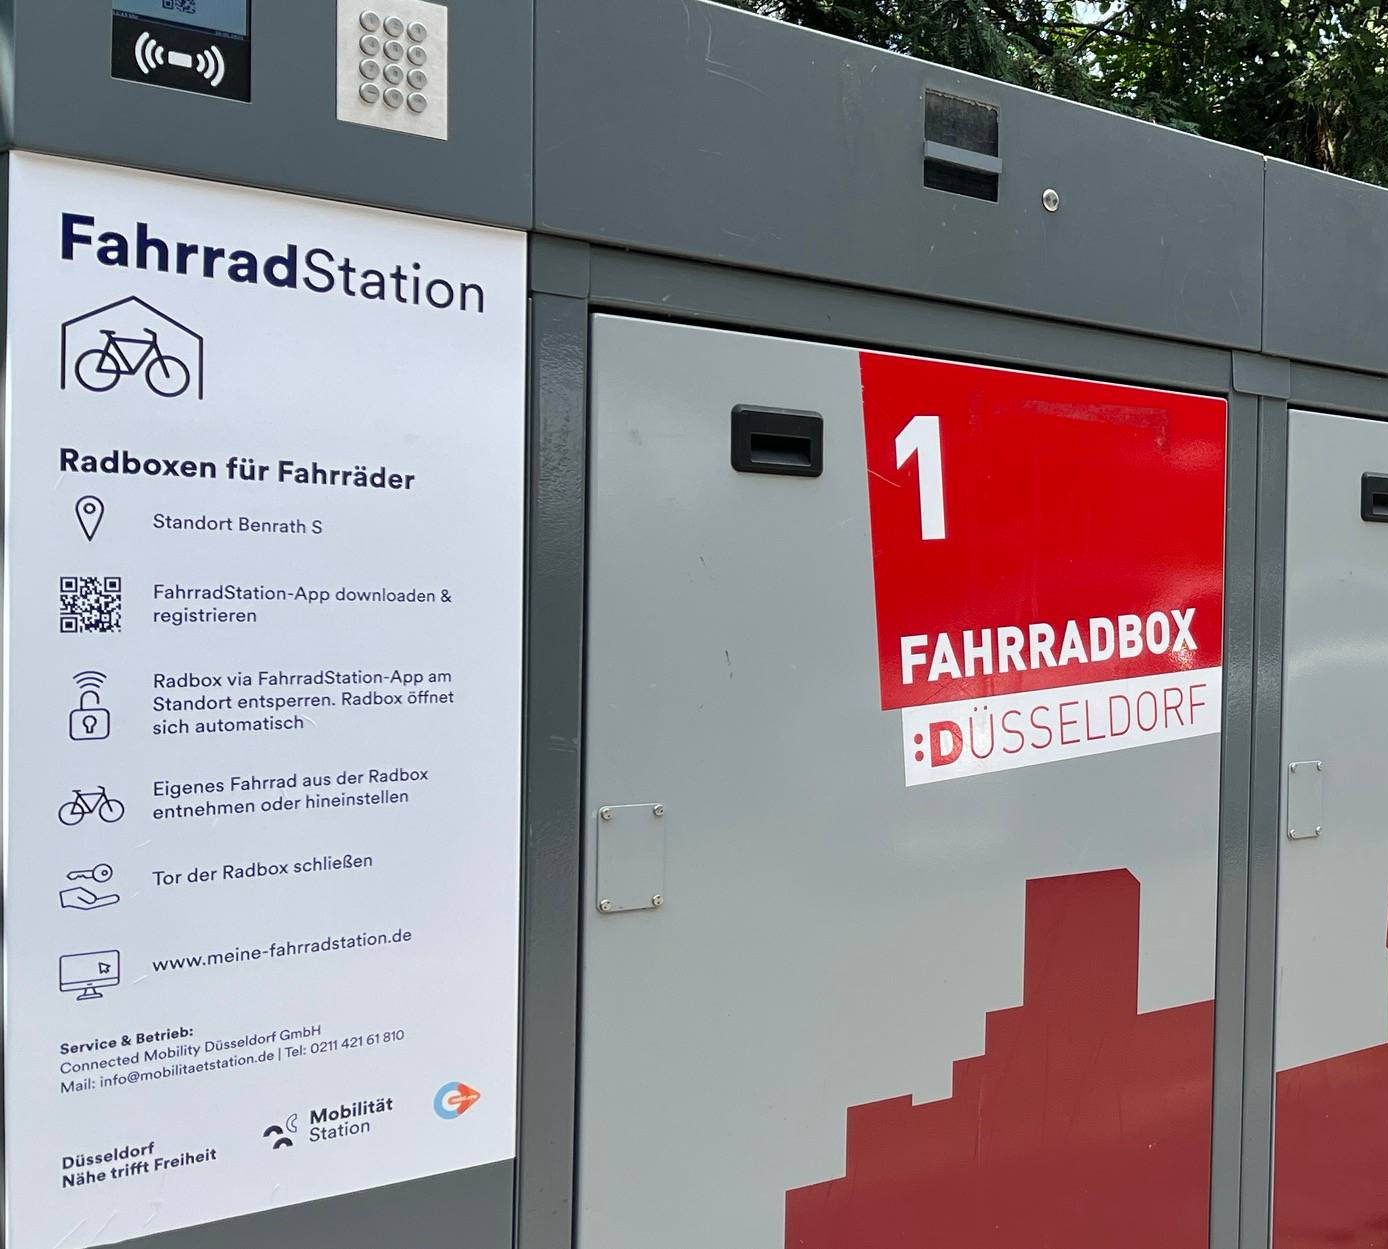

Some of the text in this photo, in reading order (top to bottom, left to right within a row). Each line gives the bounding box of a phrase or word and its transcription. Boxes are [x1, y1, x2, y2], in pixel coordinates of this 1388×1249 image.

[62, 212, 483, 313] FahrradStation
[60, 448, 415, 489] Radboxen für Fahrräder
[895, 415, 946, 540] 1
[153, 513, 322, 534] Standort Benrath S
[154, 584, 452, 604] FahrradStation-App downloaden &
[154, 608, 256, 626] registrieren
[900, 608, 1198, 684] FAHRRADBOX
[154, 670, 451, 688] Radbox via FahrradStation-App am
[153, 690, 454, 713] Standort entsperren. Radbox öffnet
[153, 715, 304, 735] sich automatisch
[154, 768, 428, 799] Eigenes Fahrrad aus der Radbox
[153, 790, 408, 819] entnehmen oder hineinstellen
[152, 854, 372, 886] Tor der Radbox schließen
[152, 928, 412, 972] www.meine-fahrradstation.de
[60, 1027, 193, 1055] Service & Betrieb:
[60, 1025, 321, 1074] Connected Mobility Düsseldorf GmbH
[61, 1078, 95, 1094] Mail:
[99, 1049, 274, 1088] info@mobilitaetstation.de
[284, 1045, 306, 1057] Tel:
[311, 1040, 337, 1054] 0211
[341, 1036, 362, 1048] 421
[367, 1033, 379, 1045] 61
[383, 1030, 404, 1042] 810
[310, 1098, 392, 1124] Mobilität
[309, 1122, 370, 1142] Station
[62, 1142, 155, 1169] Düsseldorf
[63, 1148, 216, 1188] Nähe trifft Freiheit
